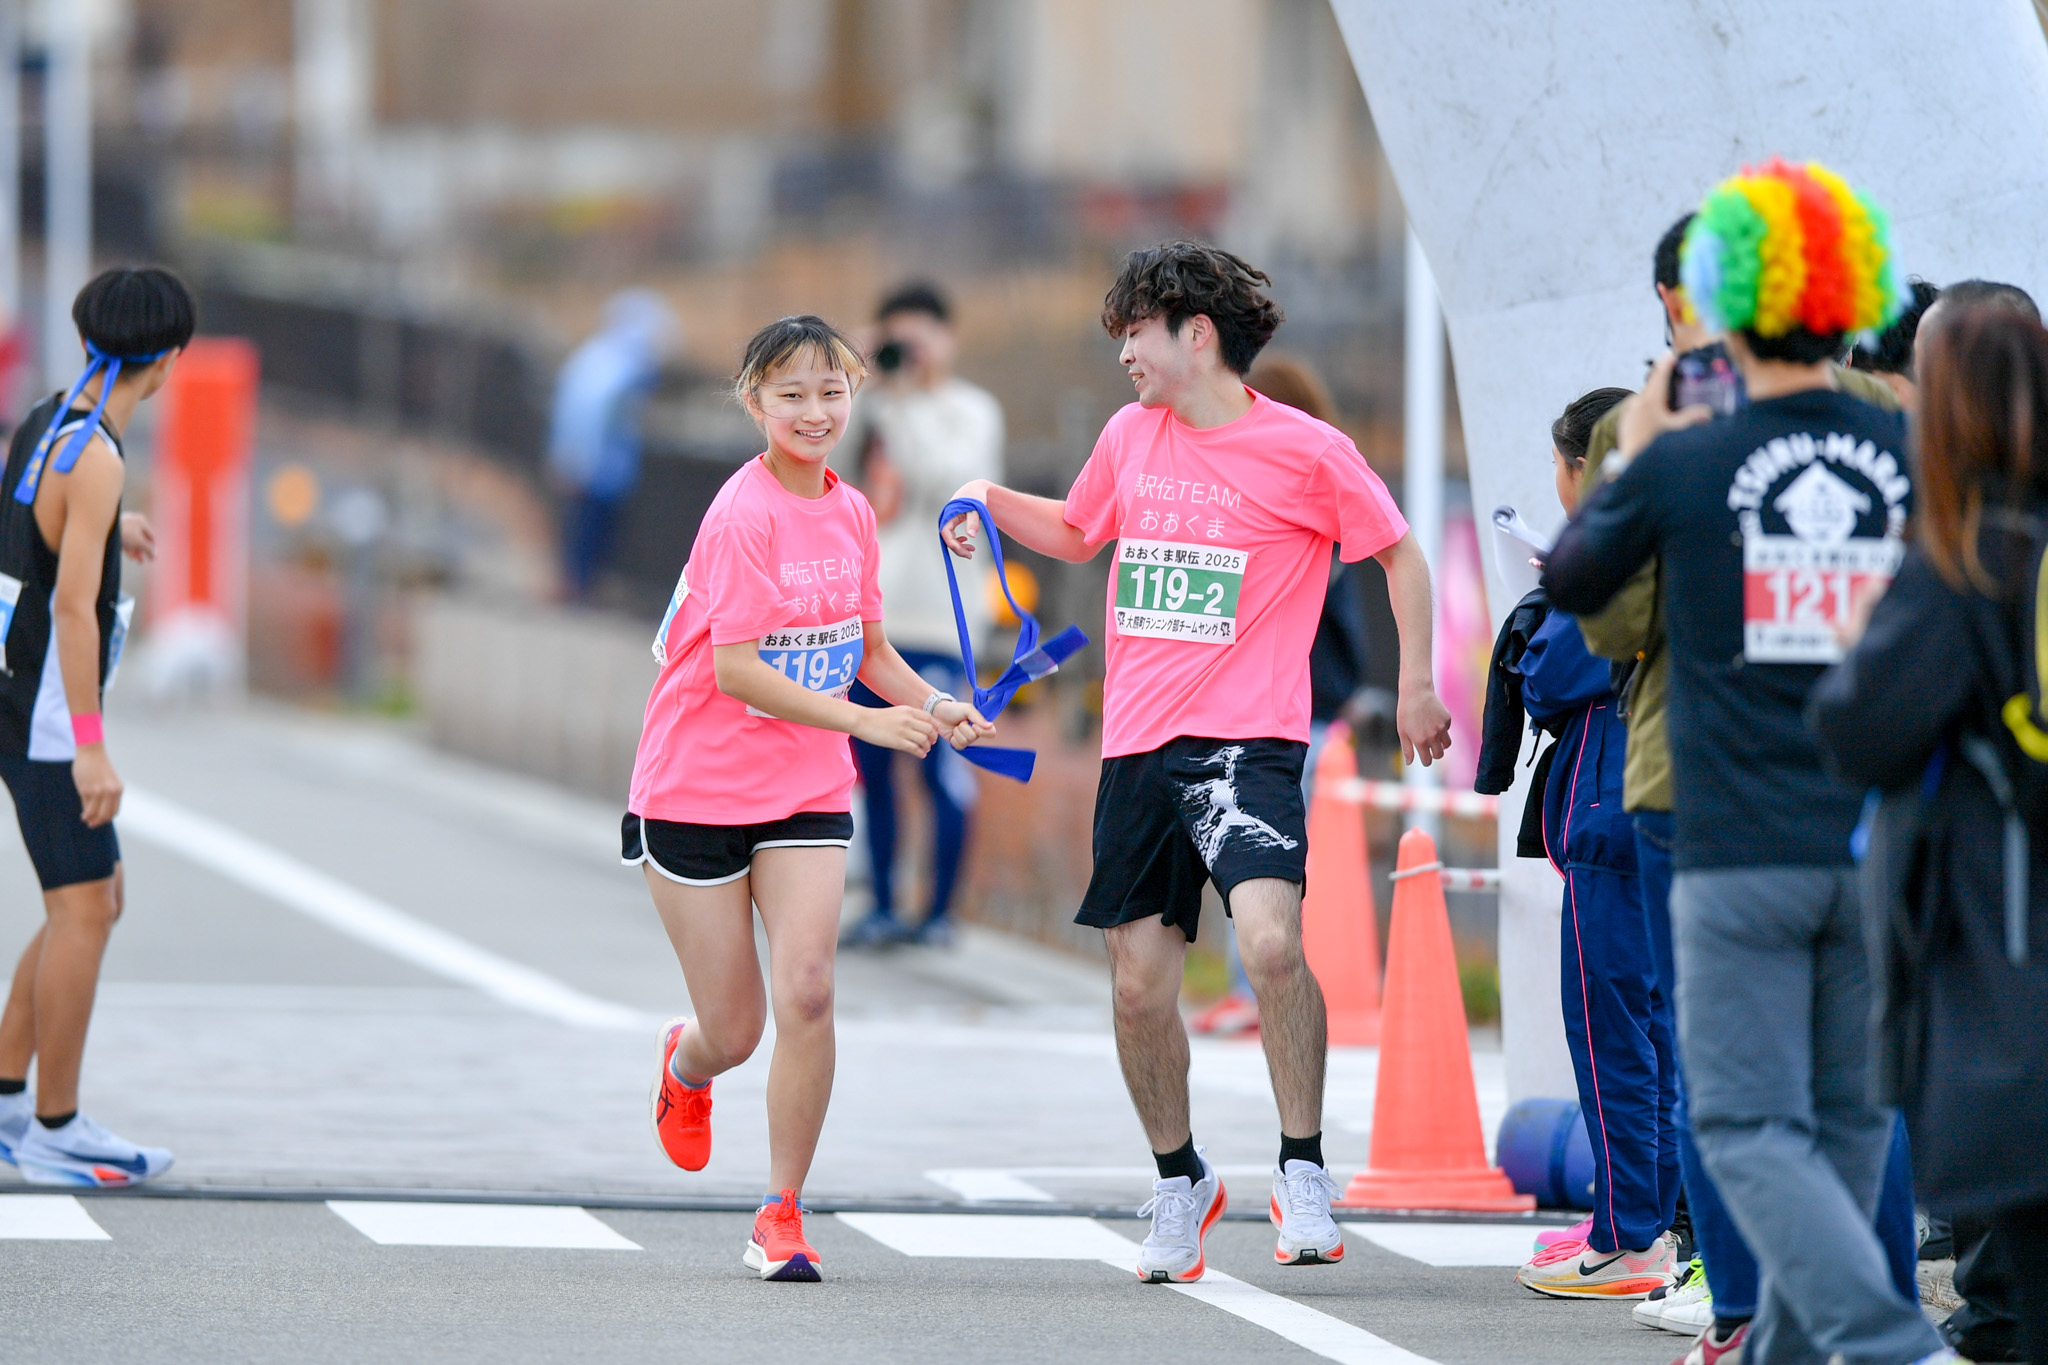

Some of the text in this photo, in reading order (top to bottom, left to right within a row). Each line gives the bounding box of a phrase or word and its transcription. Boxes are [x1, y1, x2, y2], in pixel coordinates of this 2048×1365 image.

[1135, 472, 1240, 509] 駅伝TEAM
[1140, 508, 1225, 538] おおくま
[1125, 545, 1240, 569] おおくま駅伝 2025
[1131, 565, 1225, 616] 119-2
[764, 621, 861, 647] おおくま駅伝 2025
